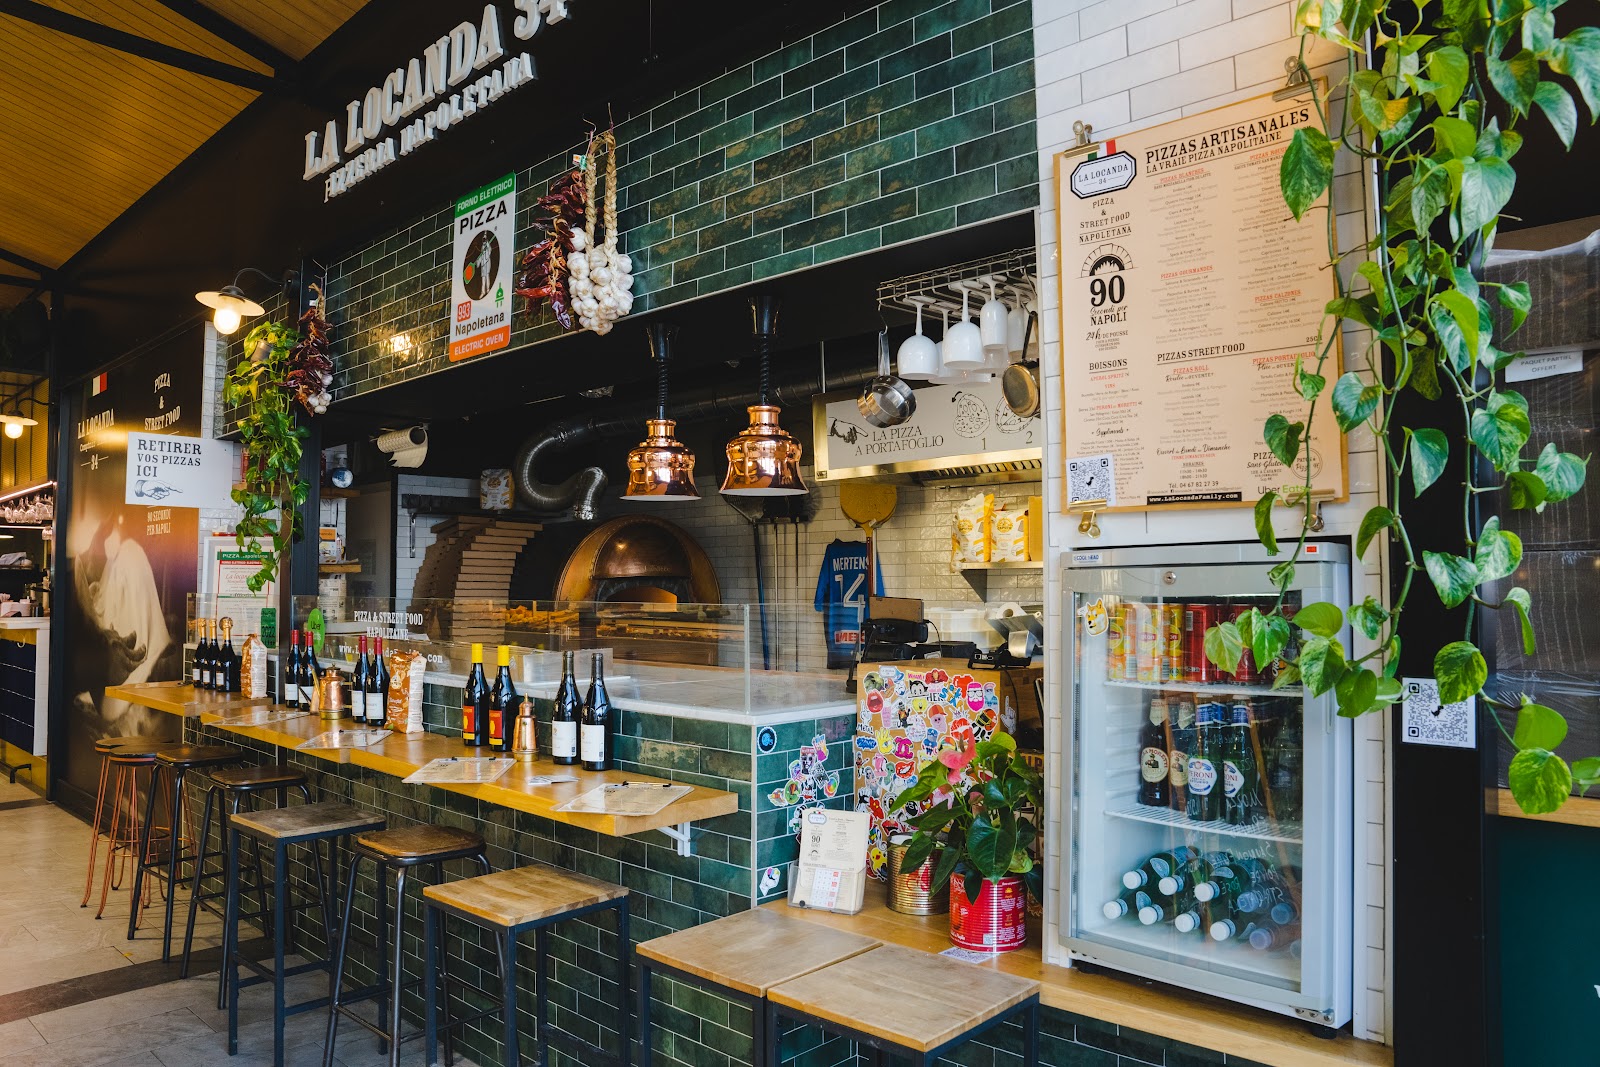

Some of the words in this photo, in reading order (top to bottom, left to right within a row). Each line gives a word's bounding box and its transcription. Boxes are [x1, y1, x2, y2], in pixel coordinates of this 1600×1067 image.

[303, 120, 340, 181] LA
[345, 3, 505, 155] LOCANDA
[324, 137, 397, 203] PIZZERIA
[400, 52, 535, 157] NAPOLETANA
[1146, 138, 1197, 165] PIZZAS
[1200, 107, 1310, 150] ARTISANALES
[1146, 164, 1158, 174] LA
[1159, 156, 1187, 171] VRAIE
[1188, 147, 1215, 163] PIZZA
[1218, 130, 1282, 156] NAPOLITAINE
[1079, 171, 1089, 183] LA
[1090, 163, 1129, 181] LOCANDA
[1098, 178, 1107, 186] 34
[457, 197, 479, 213] FORNO
[479, 177, 513, 202] ELETTRICO
[1092, 197, 1115, 209] PIZZA
[459, 200, 507, 235] PIZZA
[1080, 217, 1109, 229] STREET
[1110, 211, 1131, 224] FOOD
[1101, 208, 1106, 216] &
[1079, 226, 1132, 244] NAPOLETANA
[1160, 269, 1179, 280] PIZZAS
[1089, 274, 1125, 308] 90
[1117, 304, 1129, 316] per
[455, 311, 505, 337] Napoletana
[1090, 312, 1127, 327] NAPOLI
[1085, 327, 1101, 341] 24h
[1109, 329, 1128, 337] POUSSE
[454, 337, 484, 356] ELECTRIC
[485, 332, 504, 346] OVEN
[1157, 351, 1187, 362] PIZZAS
[1188, 346, 1220, 358] STREET
[1222, 343, 1246, 354] FOOD
[1089, 359, 1128, 371] BOISSONS
[1252, 356, 1273, 364] PIZZAS
[1520, 358, 1545, 366] PAQUET
[1532, 364, 1557, 373] OFFERT
[1173, 366, 1192, 375] PIZZAS
[154, 372, 171, 394] PIZZA
[159, 396, 165, 410] &
[78, 421, 86, 440] LA
[86, 408, 115, 435] LOCANDA
[144, 414, 165, 431] STREET
[165, 405, 181, 428] FOOD
[872, 430, 888, 442] LA
[890, 425, 922, 440] PIZZA
[981, 438, 988, 451] 1
[1025, 430, 1033, 444] 2
[138, 438, 202, 455] RETIRER
[854, 444, 864, 456] A
[865, 434, 945, 456] PORTAFOGLIO
[91, 453, 99, 471] 34
[138, 454, 159, 464] VOS
[162, 456, 202, 467] PIZZAS
[1253, 452, 1276, 460] PIZZ
[137, 465, 158, 478] ICI
[1257, 487, 1280, 496] Uber
[1282, 486, 1304, 495] Eats
[835, 573, 866, 623] 14
[310, 620, 322, 630] Uber
[354, 610, 372, 623] PIZZA
[373, 611, 378, 623] &
[379, 612, 404, 625] STREET
[404, 612, 424, 626] FOOD
[366, 626, 409, 642] NAPOLITAINE
[811, 834, 821, 844] 90
